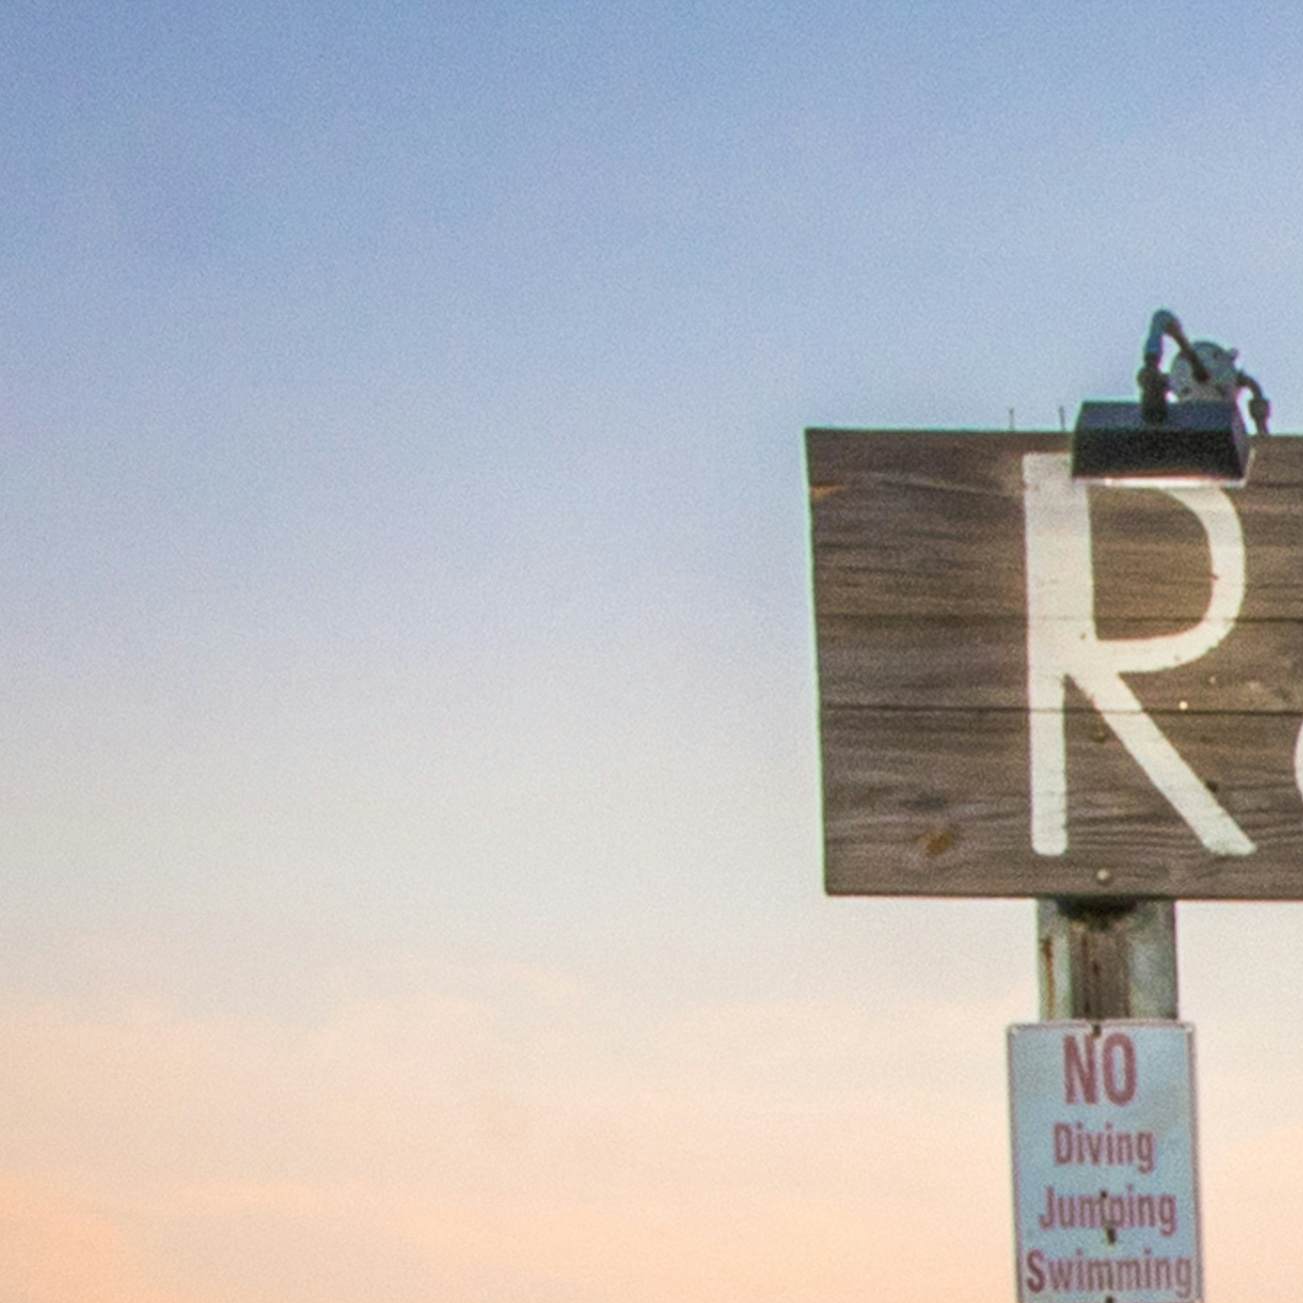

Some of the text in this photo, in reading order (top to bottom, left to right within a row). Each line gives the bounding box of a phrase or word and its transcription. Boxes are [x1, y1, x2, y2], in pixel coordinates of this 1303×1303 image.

[1063, 1032, 1137, 1106] NO
[1053, 1120, 1156, 1173] Diving
[1039, 1184, 1177, 1236] Jumping
[1026, 1249, 1193, 1298] Swimming
